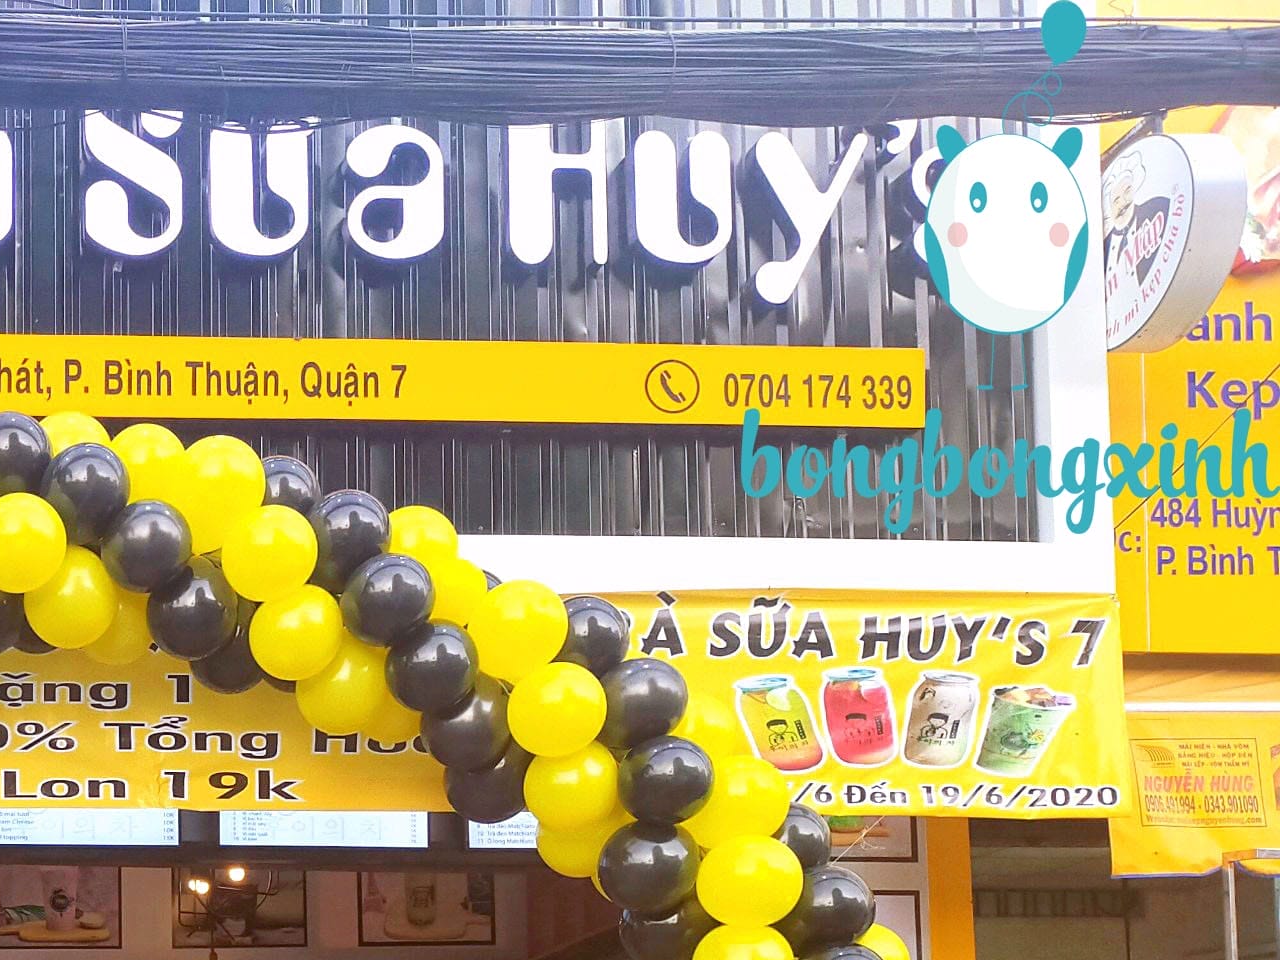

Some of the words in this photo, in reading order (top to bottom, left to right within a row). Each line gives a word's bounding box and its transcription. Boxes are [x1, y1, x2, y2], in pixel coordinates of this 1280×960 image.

[1184, 301, 1273, 342] anh
[65, 360, 91, 395] P.
[103, 355, 172, 397] Bình
[186, 362, 291, 406] Thuận,
[301, 364, 380, 407] Quận
[391, 365, 408, 399] 7
[724, 373, 791, 408] 0704
[803, 375, 851, 409] 174
[862, 375, 912, 411] 339
[1151, 498, 1201, 528] 484
[1157, 546, 1177, 576] P.
[1188, 544, 1254, 576] Bình
[710, 596, 834, 660] SỮA
[859, 613, 1048, 667] HUY'S
[1071, 619, 1106, 667] 7
[166, 673, 191, 704] 1
[103, 716, 279, 760] Tổng
[3, 770, 127, 800] Lon
[163, 769, 301, 801] 19k
[786, 782, 833, 803] /6
[844, 782, 908, 805] Đến
[921, 785, 1119, 808] 19/6/2020
[1144, 768, 1204, 793] NGUYỄN
[1210, 770, 1255, 793] HÙNG
